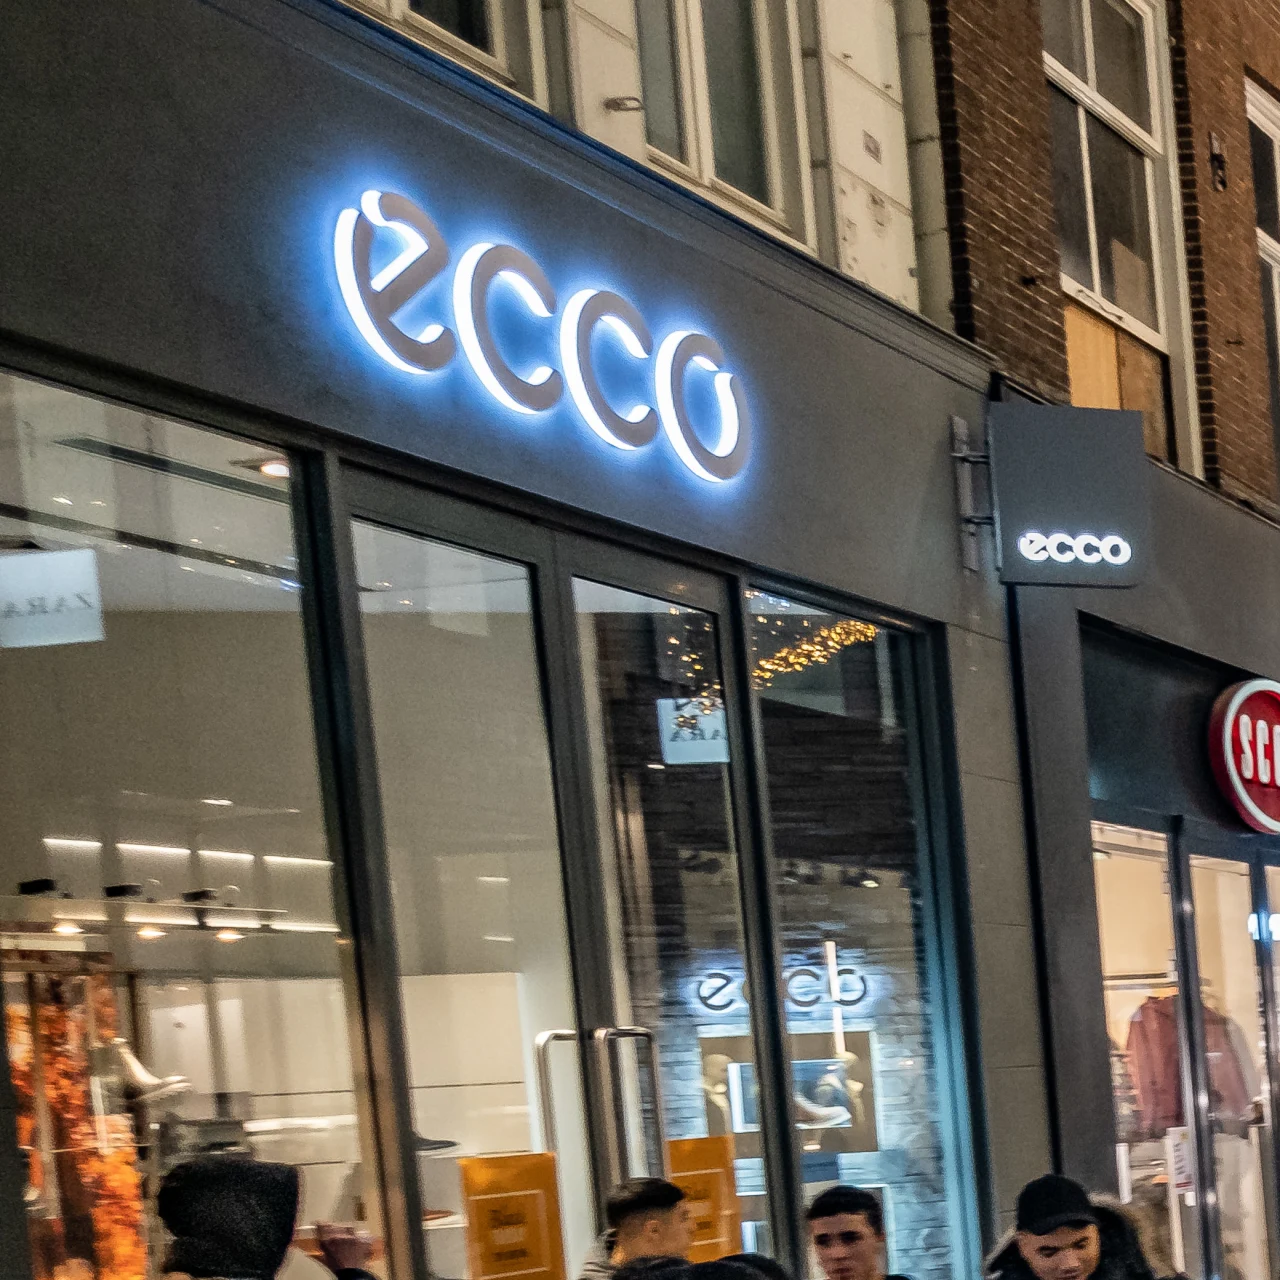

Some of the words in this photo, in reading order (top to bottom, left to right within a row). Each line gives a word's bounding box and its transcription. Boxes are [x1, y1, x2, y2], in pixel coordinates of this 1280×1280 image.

[334, 190, 752, 484] ecco
[1019, 532, 1132, 565] ecco
[698, 968, 867, 1011] eco
